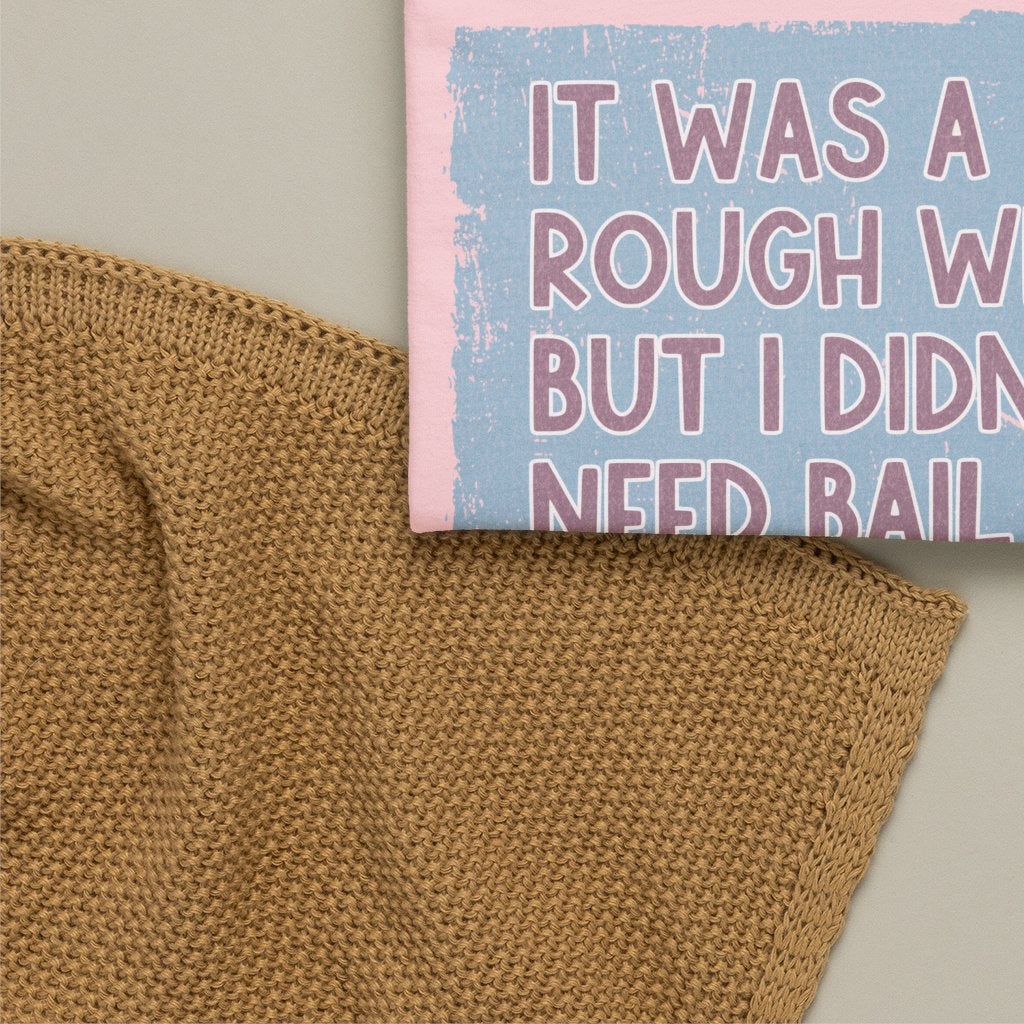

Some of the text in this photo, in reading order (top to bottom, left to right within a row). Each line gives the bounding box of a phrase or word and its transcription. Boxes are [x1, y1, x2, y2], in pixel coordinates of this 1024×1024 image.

[529, 76, 989, 185] IT WAS A
[529, 203, 883, 311] ROUGH
[529, 333, 724, 436] BUT
[758, 334, 784, 435] I
[529, 458, 771, 535] NEED
[805, 457, 1012, 543] BAIL
